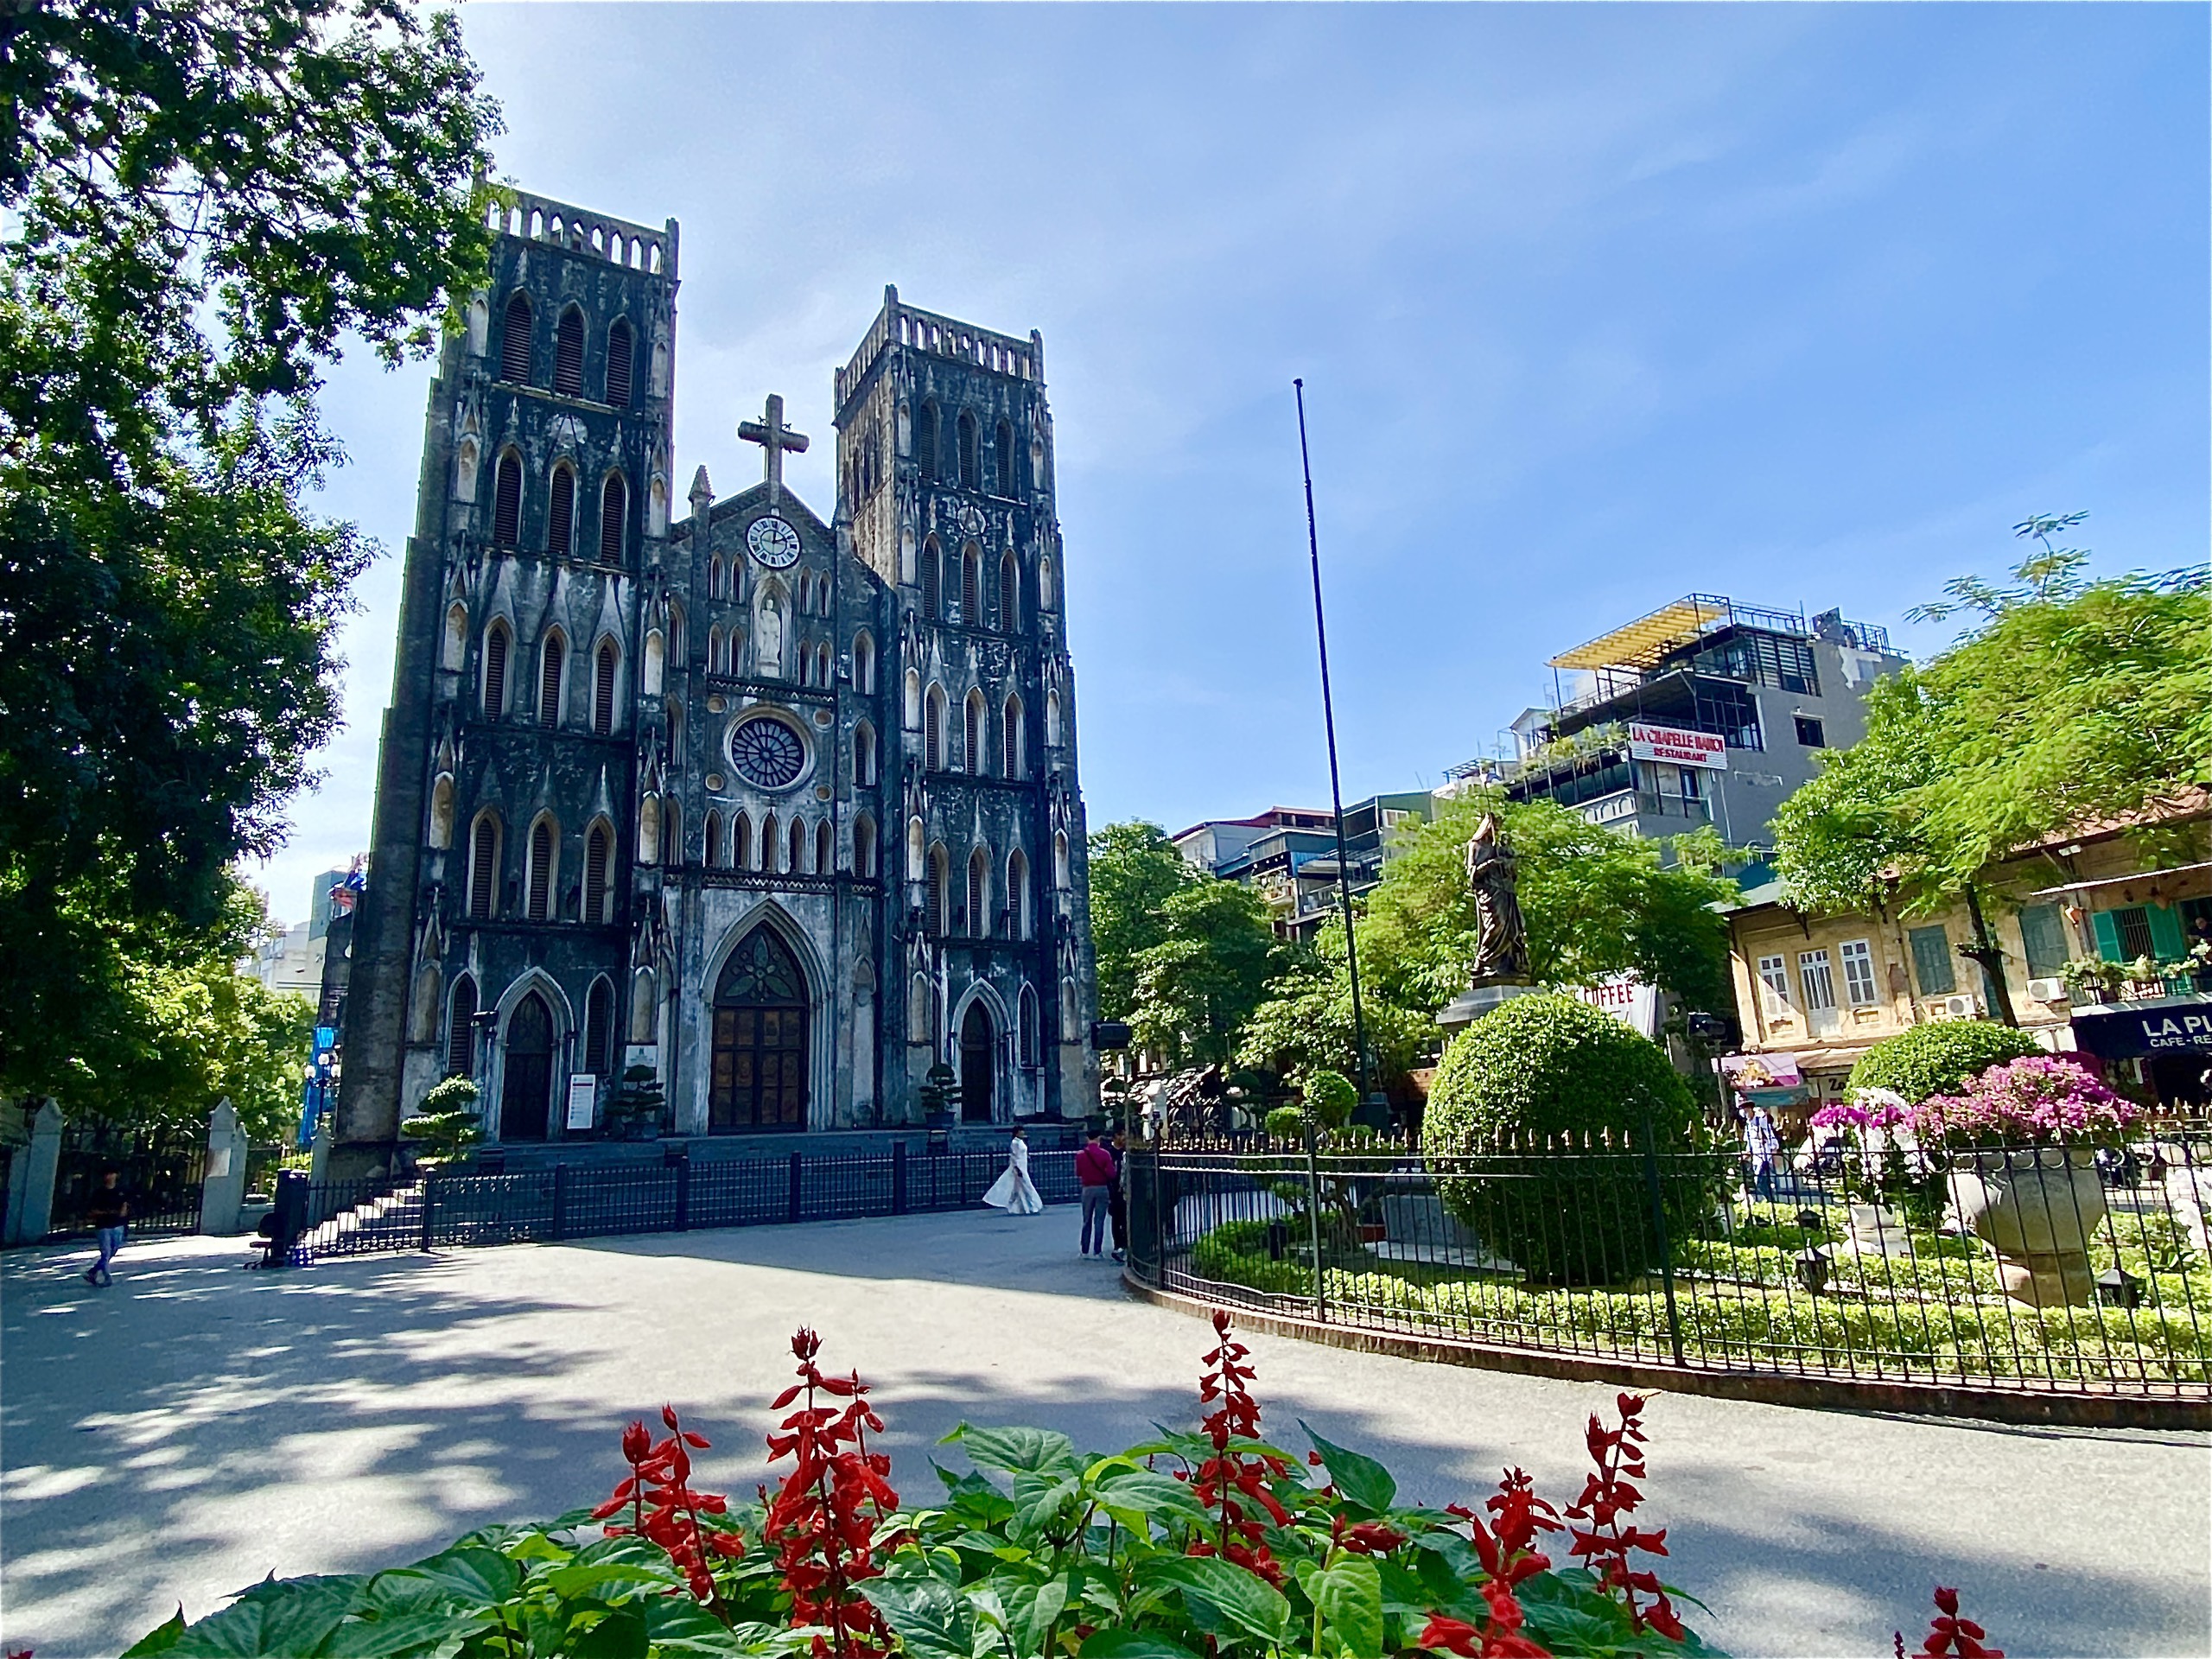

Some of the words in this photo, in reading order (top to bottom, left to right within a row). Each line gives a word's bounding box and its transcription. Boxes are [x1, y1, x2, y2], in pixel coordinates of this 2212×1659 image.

[1632, 727, 1645, 742] LA
[1647, 729, 1694, 748] CHAPELLE
[1694, 736, 1724, 753] HANOI
[1653, 747, 1707, 762] RESTAURANT
[2142, 1018, 2182, 1037] LA
[2150, 1037, 2186, 1047] CAFE
[1828, 1077, 1848, 1091] Zo
